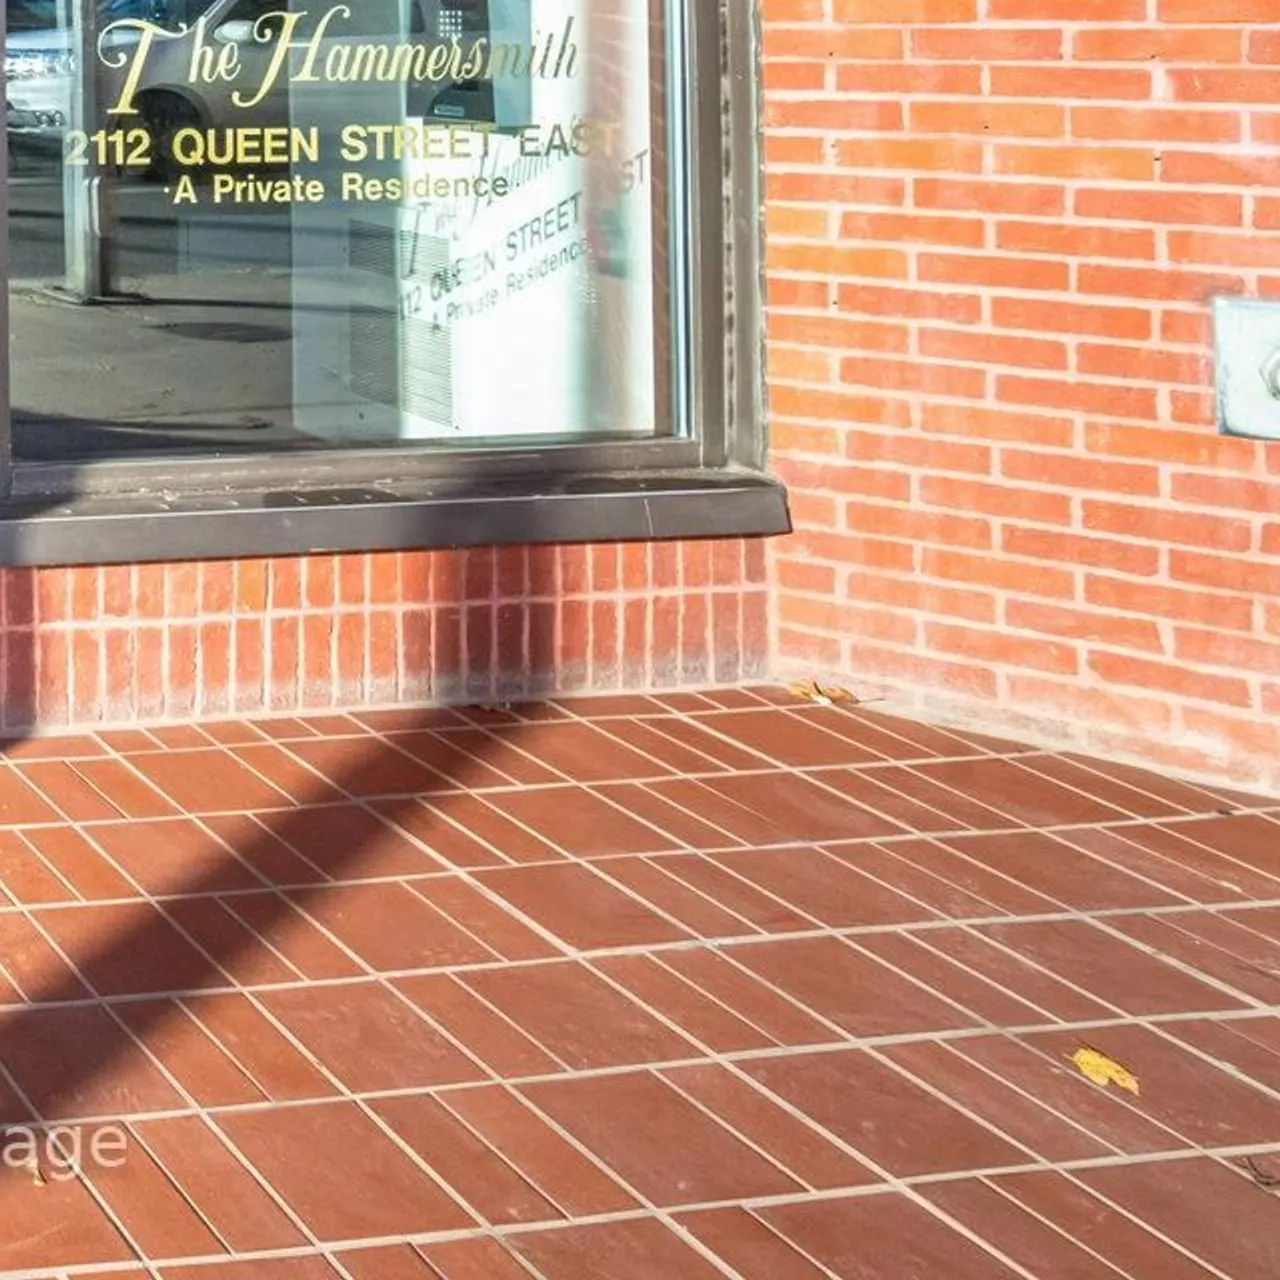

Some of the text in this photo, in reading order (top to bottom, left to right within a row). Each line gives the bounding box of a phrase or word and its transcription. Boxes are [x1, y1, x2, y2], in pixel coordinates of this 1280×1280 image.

[97, 5, 578, 114] The Hammersmith
[64, 121, 619, 166] 2112 QUEEN STREET EAST
[173, 173, 510, 203] A Private Residence
